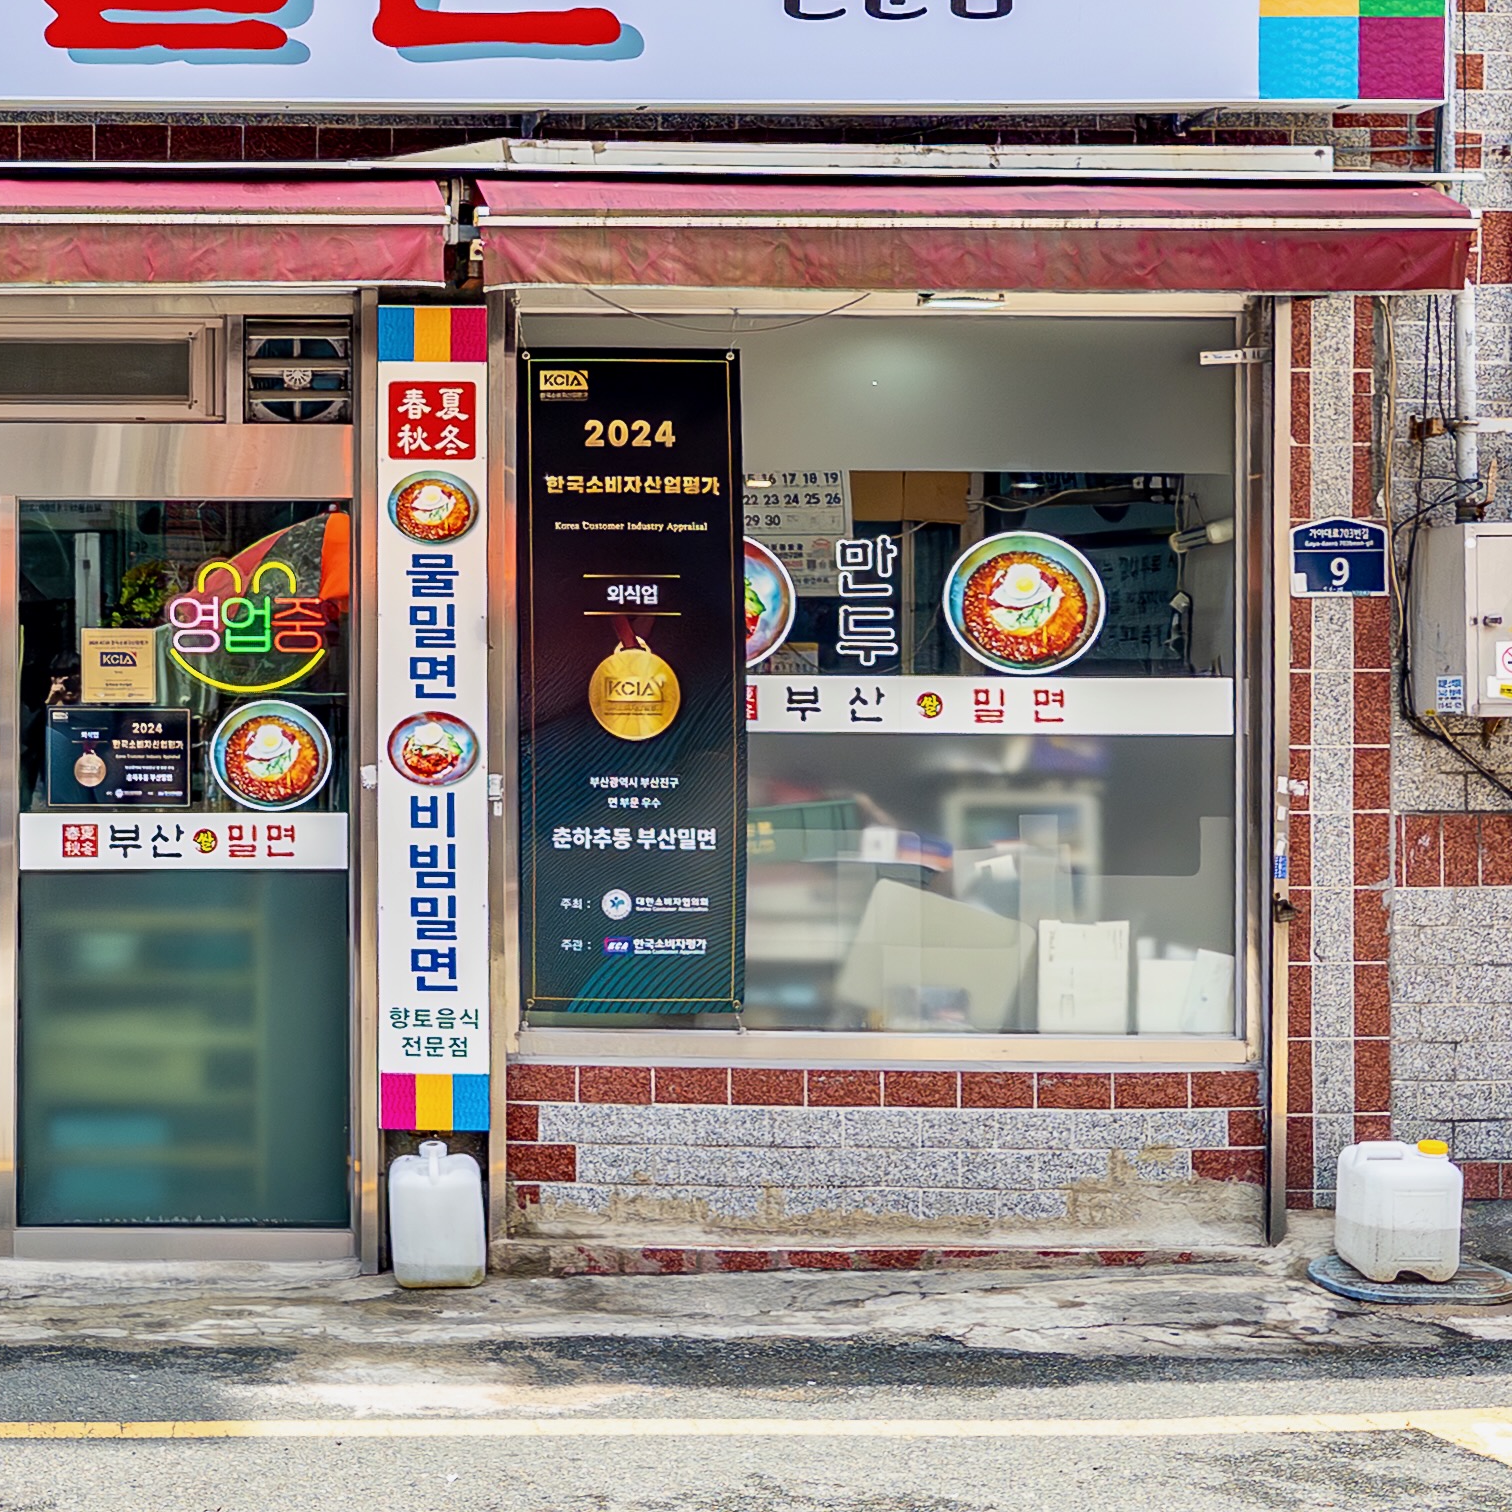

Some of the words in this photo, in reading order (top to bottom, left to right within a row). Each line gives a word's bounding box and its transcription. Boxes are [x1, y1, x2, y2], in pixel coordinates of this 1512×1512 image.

[543, 373, 583, 387] KCIA
[584, 419, 676, 448] 2024
[545, 475, 720, 496] 한국소비자산업평가
[782, 473, 796, 485] 17
[803, 472, 817, 484] 18
[824, 472, 838, 484] 19
[743, 494, 758, 506] 22
[763, 493, 779, 505] 23
[783, 493, 799, 506] 24
[804, 492, 820, 505] 25
[825, 492, 841, 505] 26
[554, 521, 580, 530] Korea
[582, 521, 624, 530] Customer
[627, 521, 664, 532] Industry
[666, 521, 708, 532] Appraisal
[744, 514, 760, 527] 29
[764, 514, 781, 527] 30
[1329, 556, 1351, 587] 9
[606, 584, 659, 605] 외식업
[834, 534, 899, 667] 만두
[169, 596, 327, 653] 영업중
[406, 553, 459, 700] 물밀면
[102, 654, 134, 665] KCIA
[608, 680, 655, 696] KCIA
[785, 686, 886, 723] 부산
[972, 688, 1066, 724] 밀면
[131, 722, 163, 734] 2024
[641, 797, 662, 809] 우수
[109, 824, 185, 859] 부산
[228, 824, 296, 858] 밀면
[551, 826, 633, 850] 춘하추동
[636, 826, 717, 851] 부산밀면
[409, 791, 459, 992] 비빔밀면
[560, 897, 583, 910] 주최
[560, 939, 583, 951] 주관
[389, 1006, 479, 1030] 향토음식
[401, 1035, 468, 1058] 전문점
